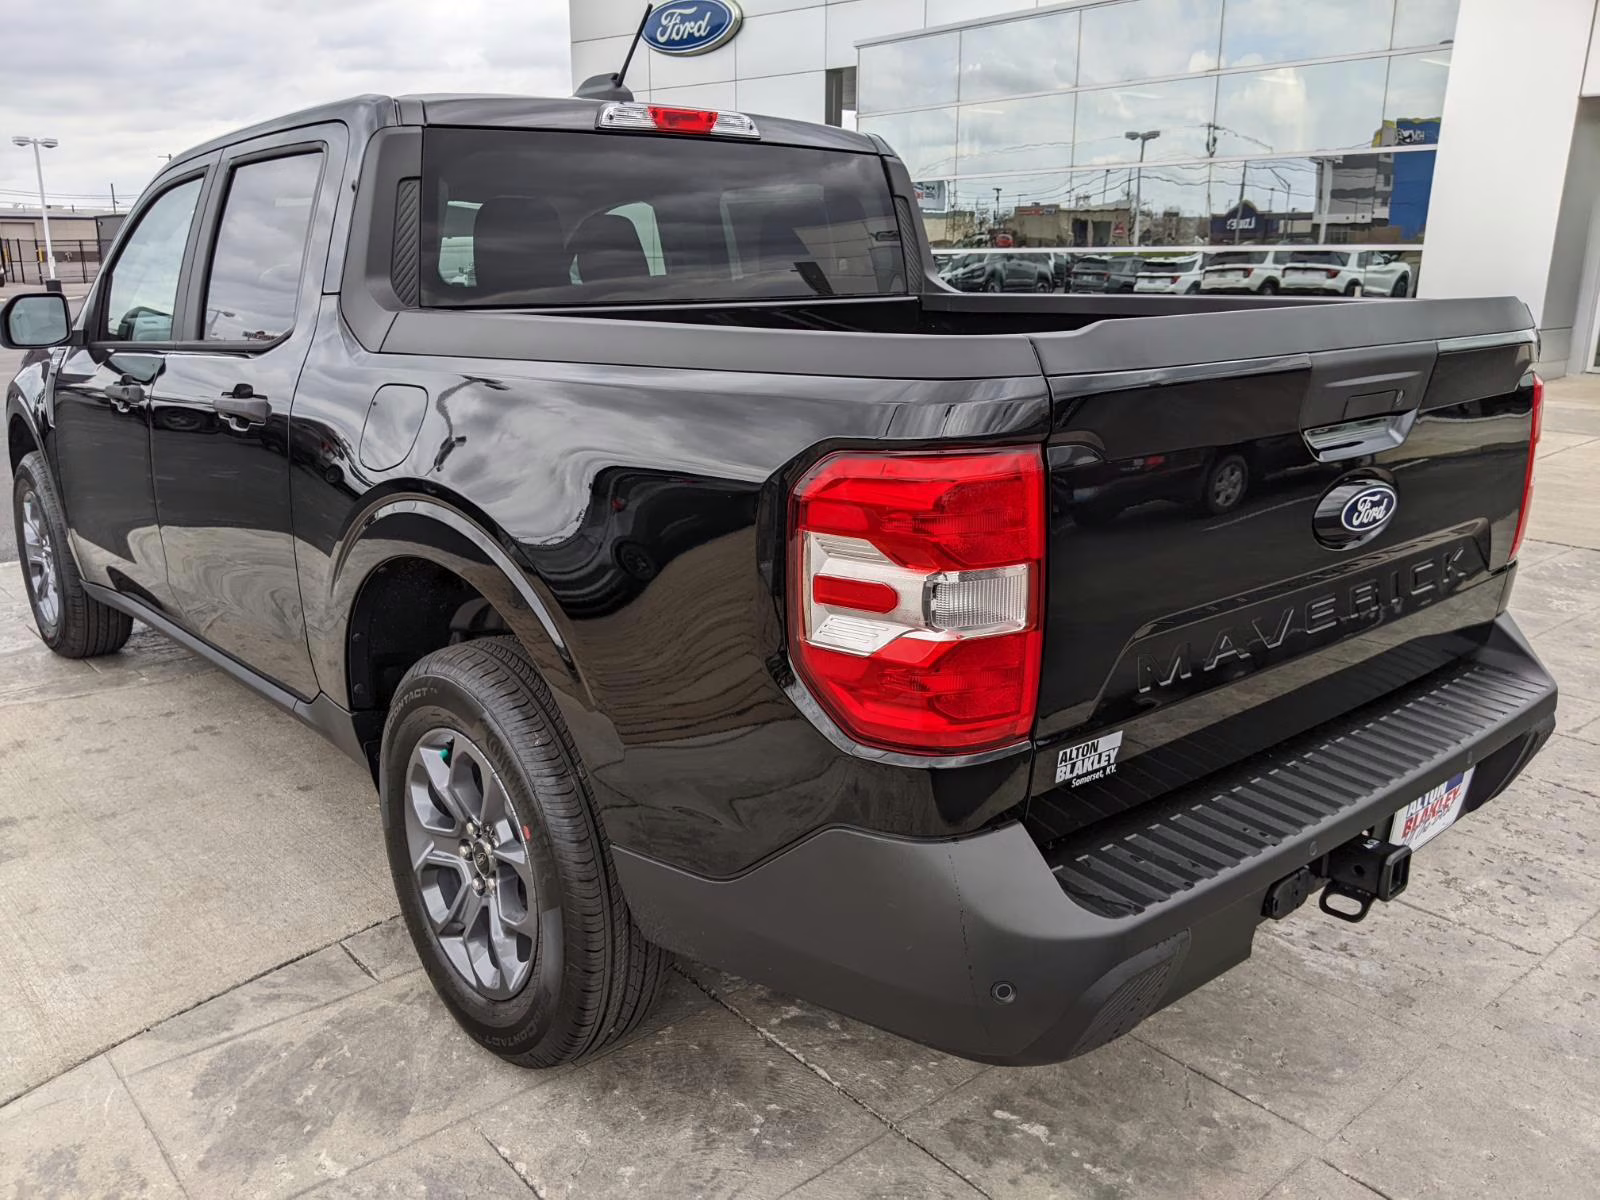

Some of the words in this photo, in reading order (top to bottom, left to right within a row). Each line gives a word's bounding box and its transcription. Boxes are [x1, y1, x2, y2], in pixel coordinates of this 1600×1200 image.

[656, 6, 711, 43] Ford
[1353, 493, 1387, 526] Ford
[1138, 547, 1466, 693] MAVERICK
[1055, 747, 1119, 784] BLAKLEY
[1058, 740, 1100, 766] ALTON
[1401, 785, 1462, 839] BLAKLEY
